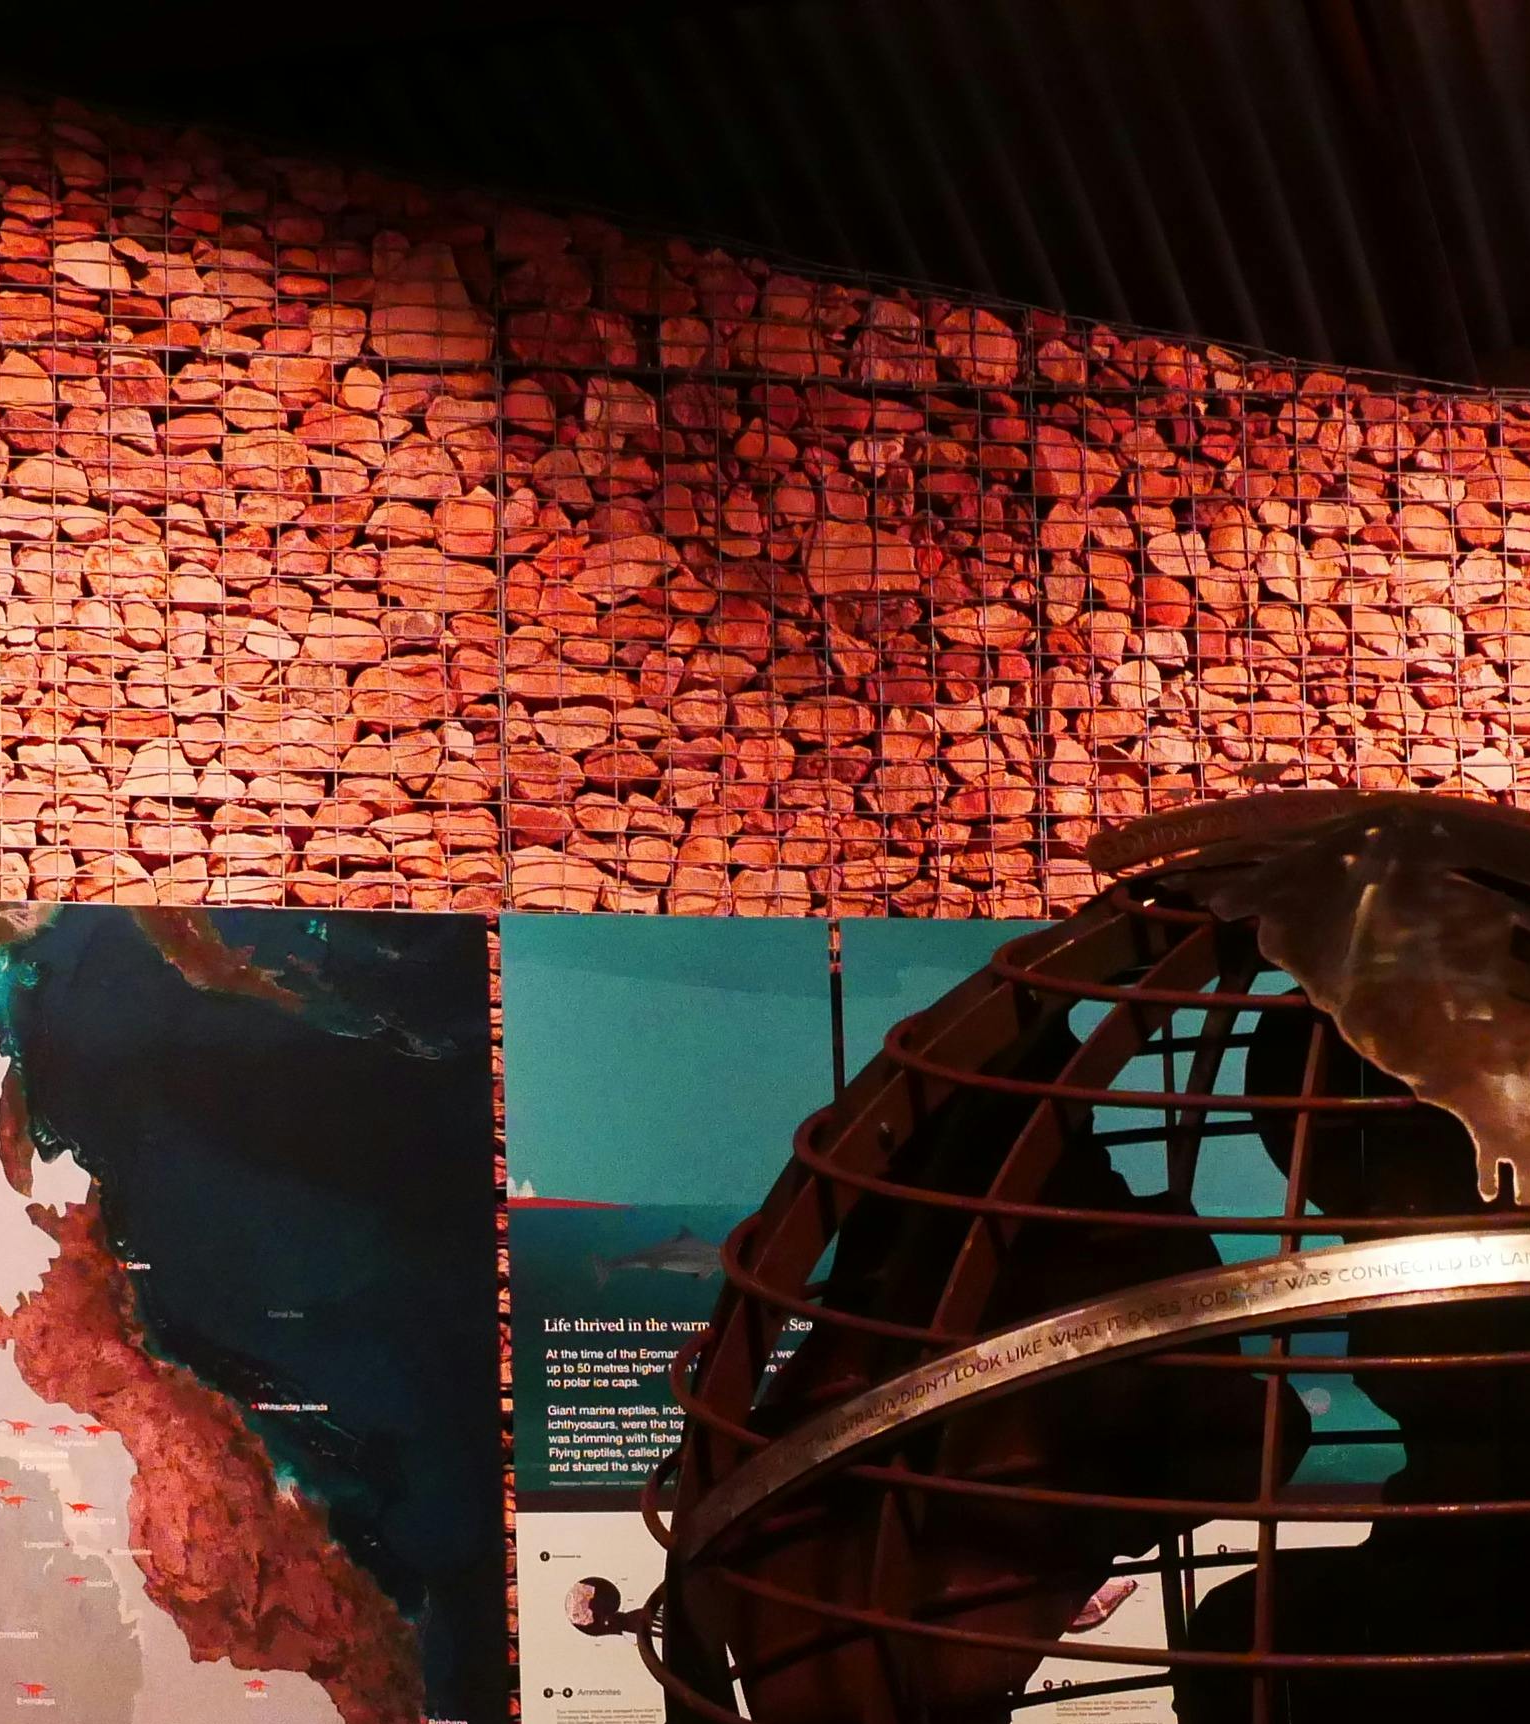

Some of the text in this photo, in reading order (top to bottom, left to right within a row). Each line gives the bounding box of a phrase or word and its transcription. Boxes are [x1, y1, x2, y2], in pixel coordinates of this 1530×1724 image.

[126, 1261, 151, 1270] Cairns
[543, 1317, 572, 1334] Life
[574, 1317, 625, 1333] thrived
[628, 1318, 642, 1333] in
[645, 1316, 668, 1333] the
[789, 1318, 813, 1332] Sea
[824, 1399, 895, 1441] AUSTRALIA
[901, 1372, 950, 1404] DIDN'T
[955, 1353, 1001, 1384] LOOK
[1006, 1339, 1043, 1364] LIKE
[1047, 1321, 1100, 1348] WHAT
[1107, 1315, 1121, 1332] IT
[1128, 1303, 1182, 1329] DOES
[1263, 1279, 1279, 1295] IT
[1285, 1271, 1331, 1290] WAS
[1338, 1251, 1464, 1281] CONNECTED
[1470, 1253, 1492, 1269] BY
[545, 1348, 638, 1360] At the time of the
[545, 1362, 666, 1377] up to 50 metres higher
[546, 1378, 561, 1388] no
[563, 1376, 592, 1391] polar
[593, 1376, 610, 1388] ice
[547, 1404, 577, 1416] Giant
[578, 1404, 616, 1416] marine
[621, 1420, 648, 1430] were
[649, 1418, 668, 1430] the
[548, 1432, 682, 1448] was brimming with fishes
[548, 1446, 582, 1462] Flying
[627, 1446, 660, 1458] called
[548, 1460, 650, 1476] and shared the sky
[577, 1687, 622, 1696] Ammonites
